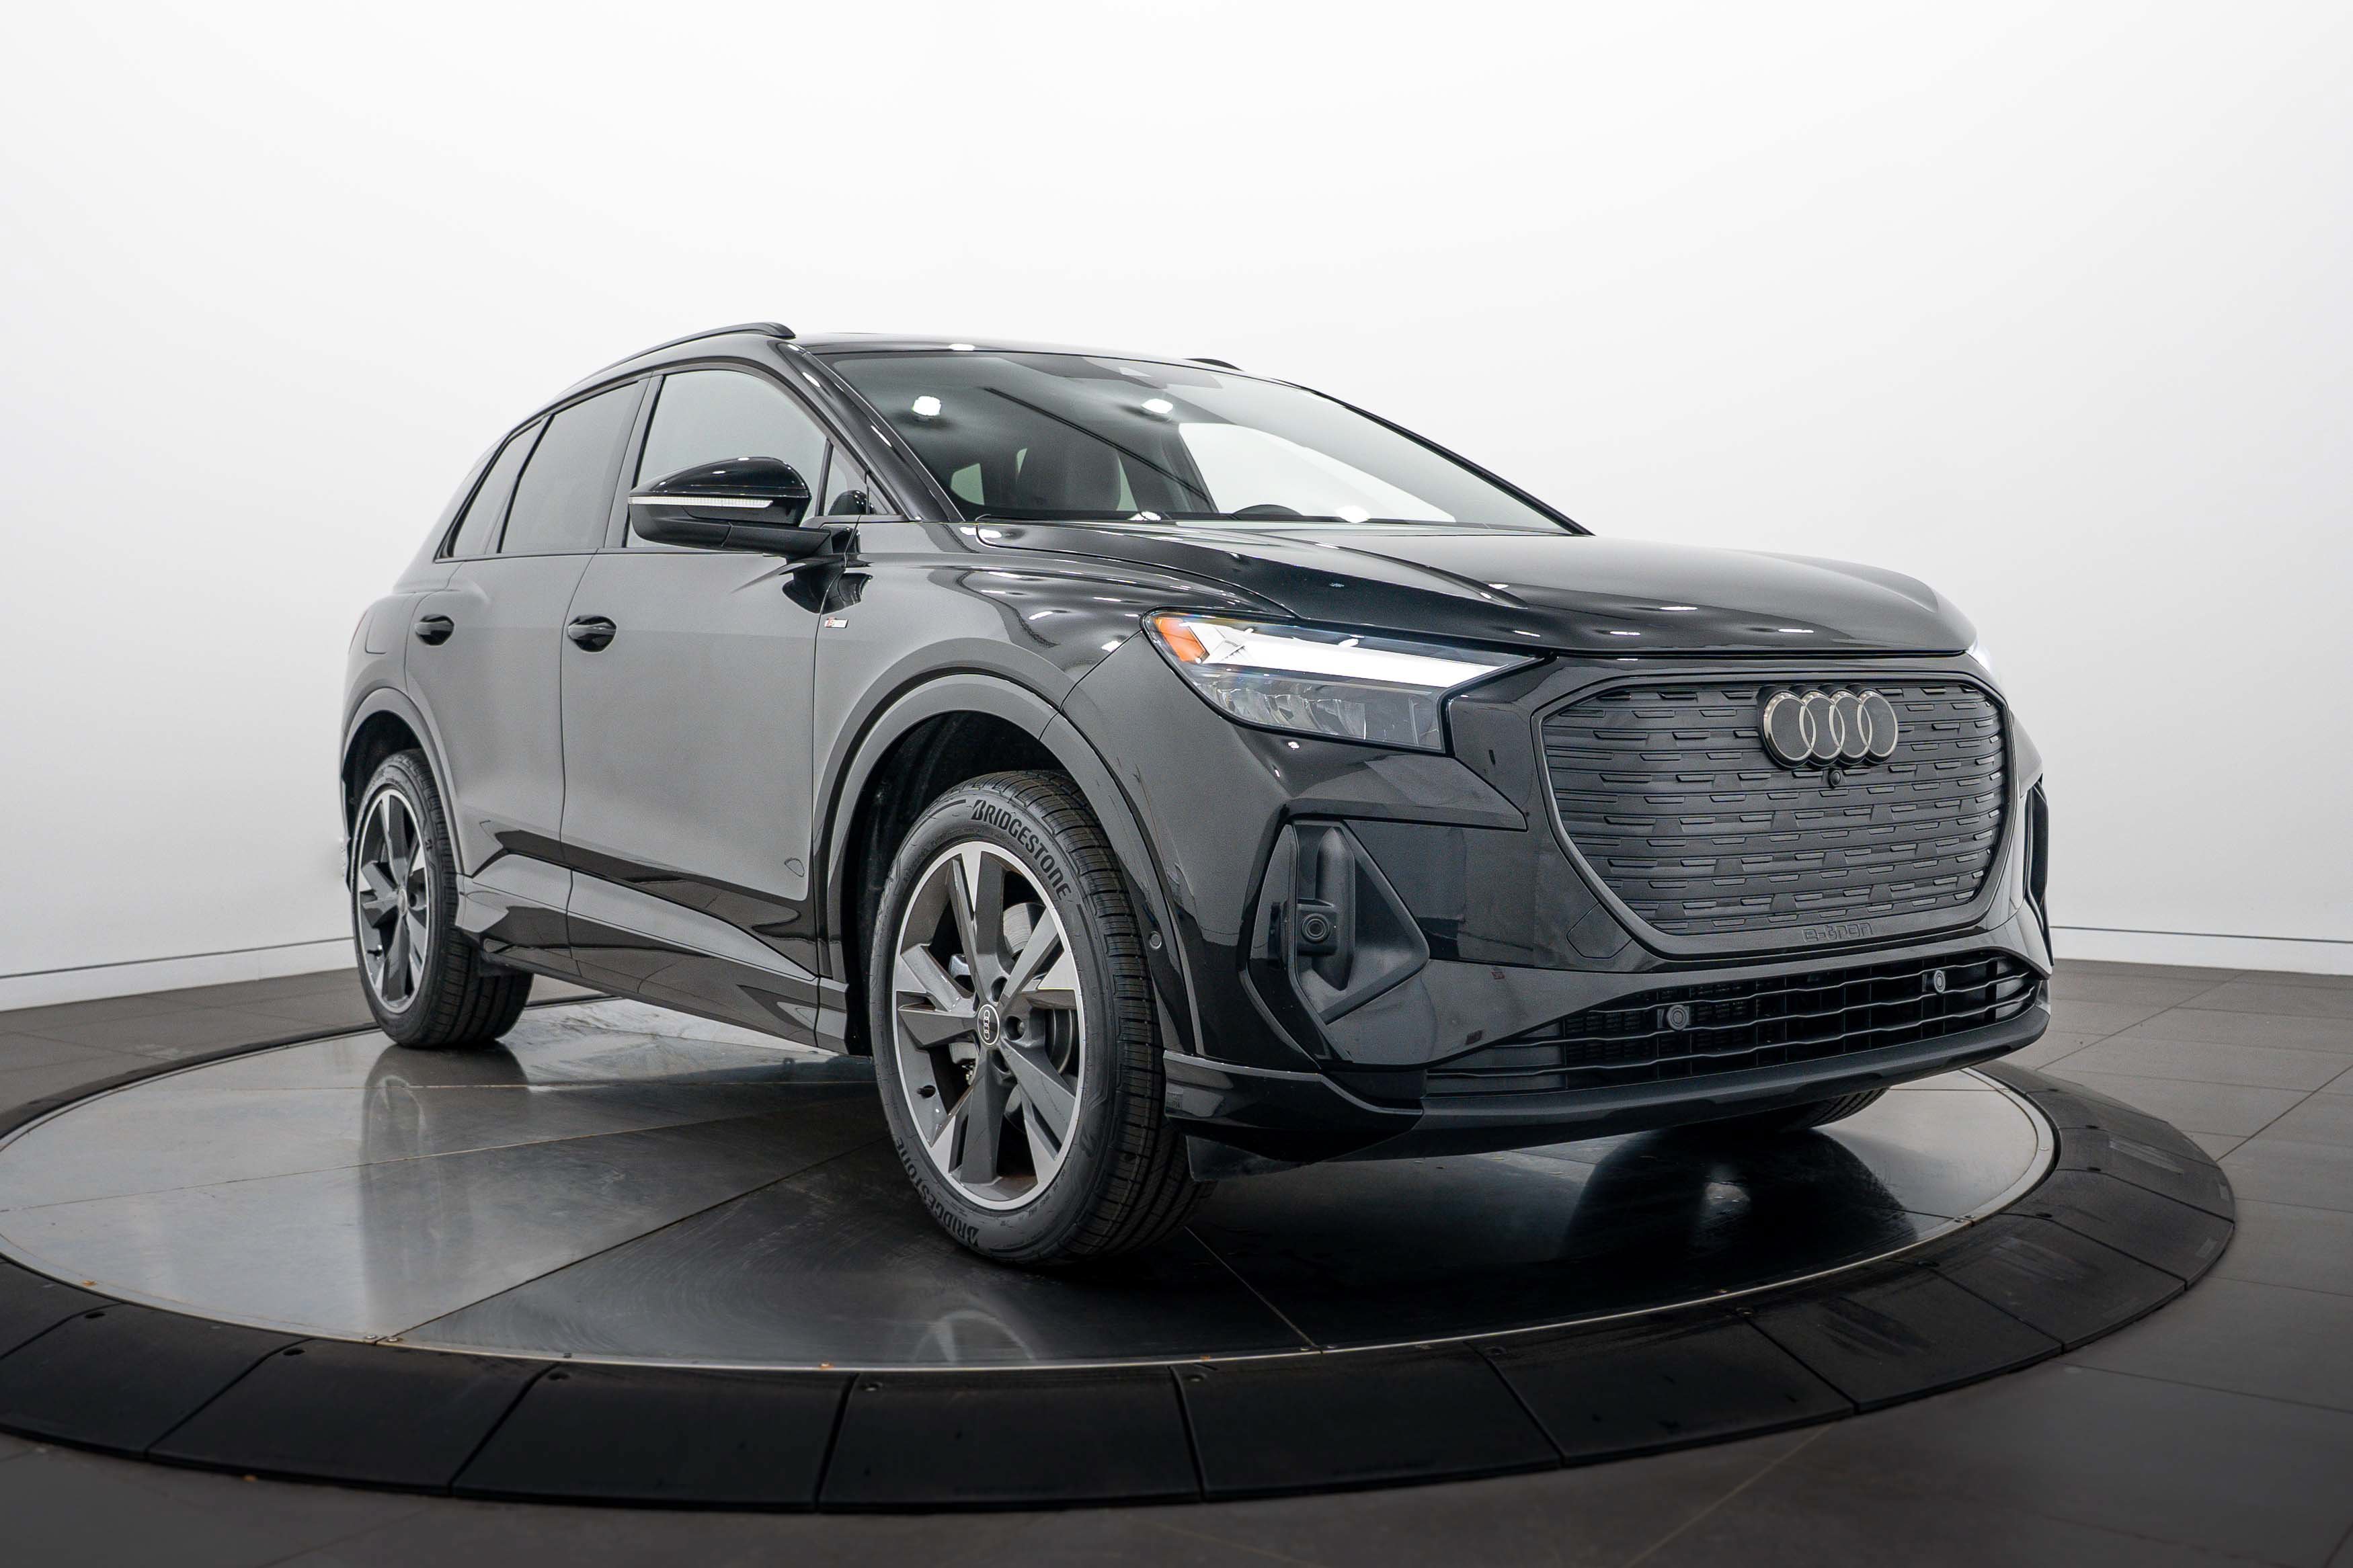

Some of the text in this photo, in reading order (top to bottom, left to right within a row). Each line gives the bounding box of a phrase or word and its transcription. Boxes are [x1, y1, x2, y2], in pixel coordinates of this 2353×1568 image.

[971, 800, 1071, 900] BRIDGESTONE
[1802, 923, 1872, 942] e-tron
[895, 1138, 979, 1247] BRIDGESTONE
